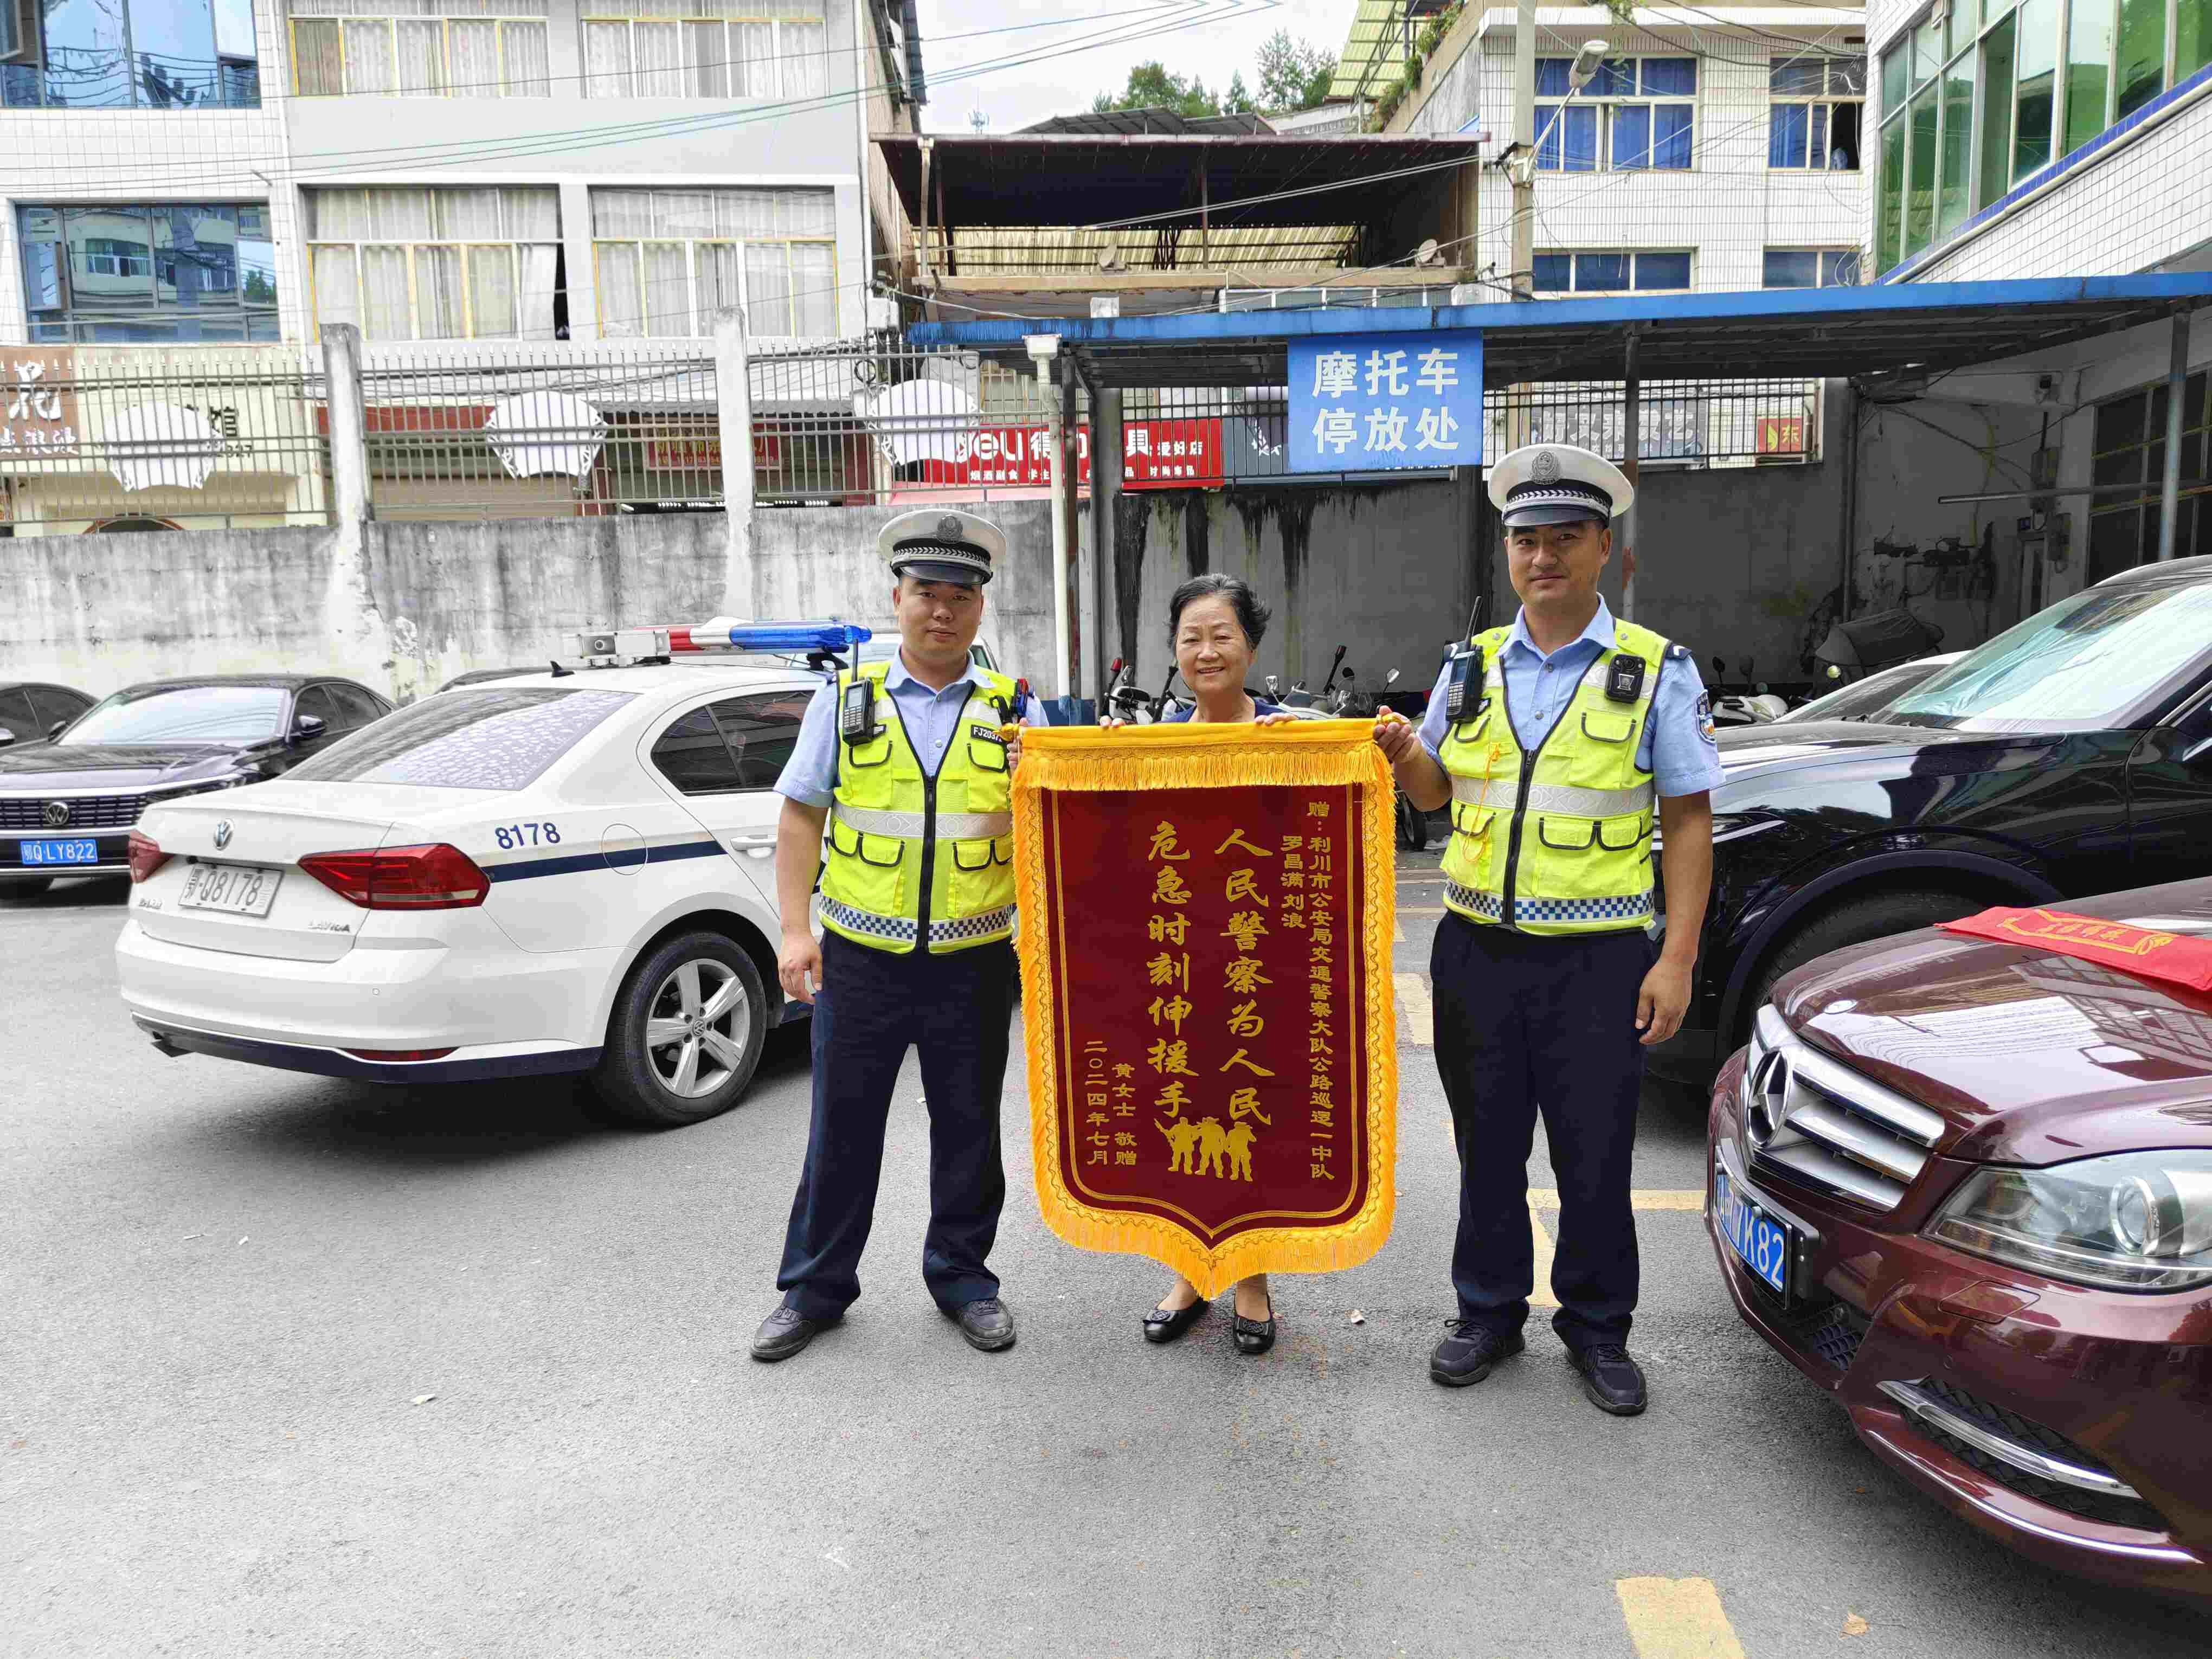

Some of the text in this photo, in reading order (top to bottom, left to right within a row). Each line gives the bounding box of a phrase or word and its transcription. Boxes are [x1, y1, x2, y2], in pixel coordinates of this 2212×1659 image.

[1311, 348, 1458, 398] 摩托车
[1311, 406, 1459, 454] 停放处
[495, 822, 561, 849] 8178
[1147, 820, 1199, 1118] 危急时刻伸援手
[1214, 828, 1276, 1126] 人民警察为人民
